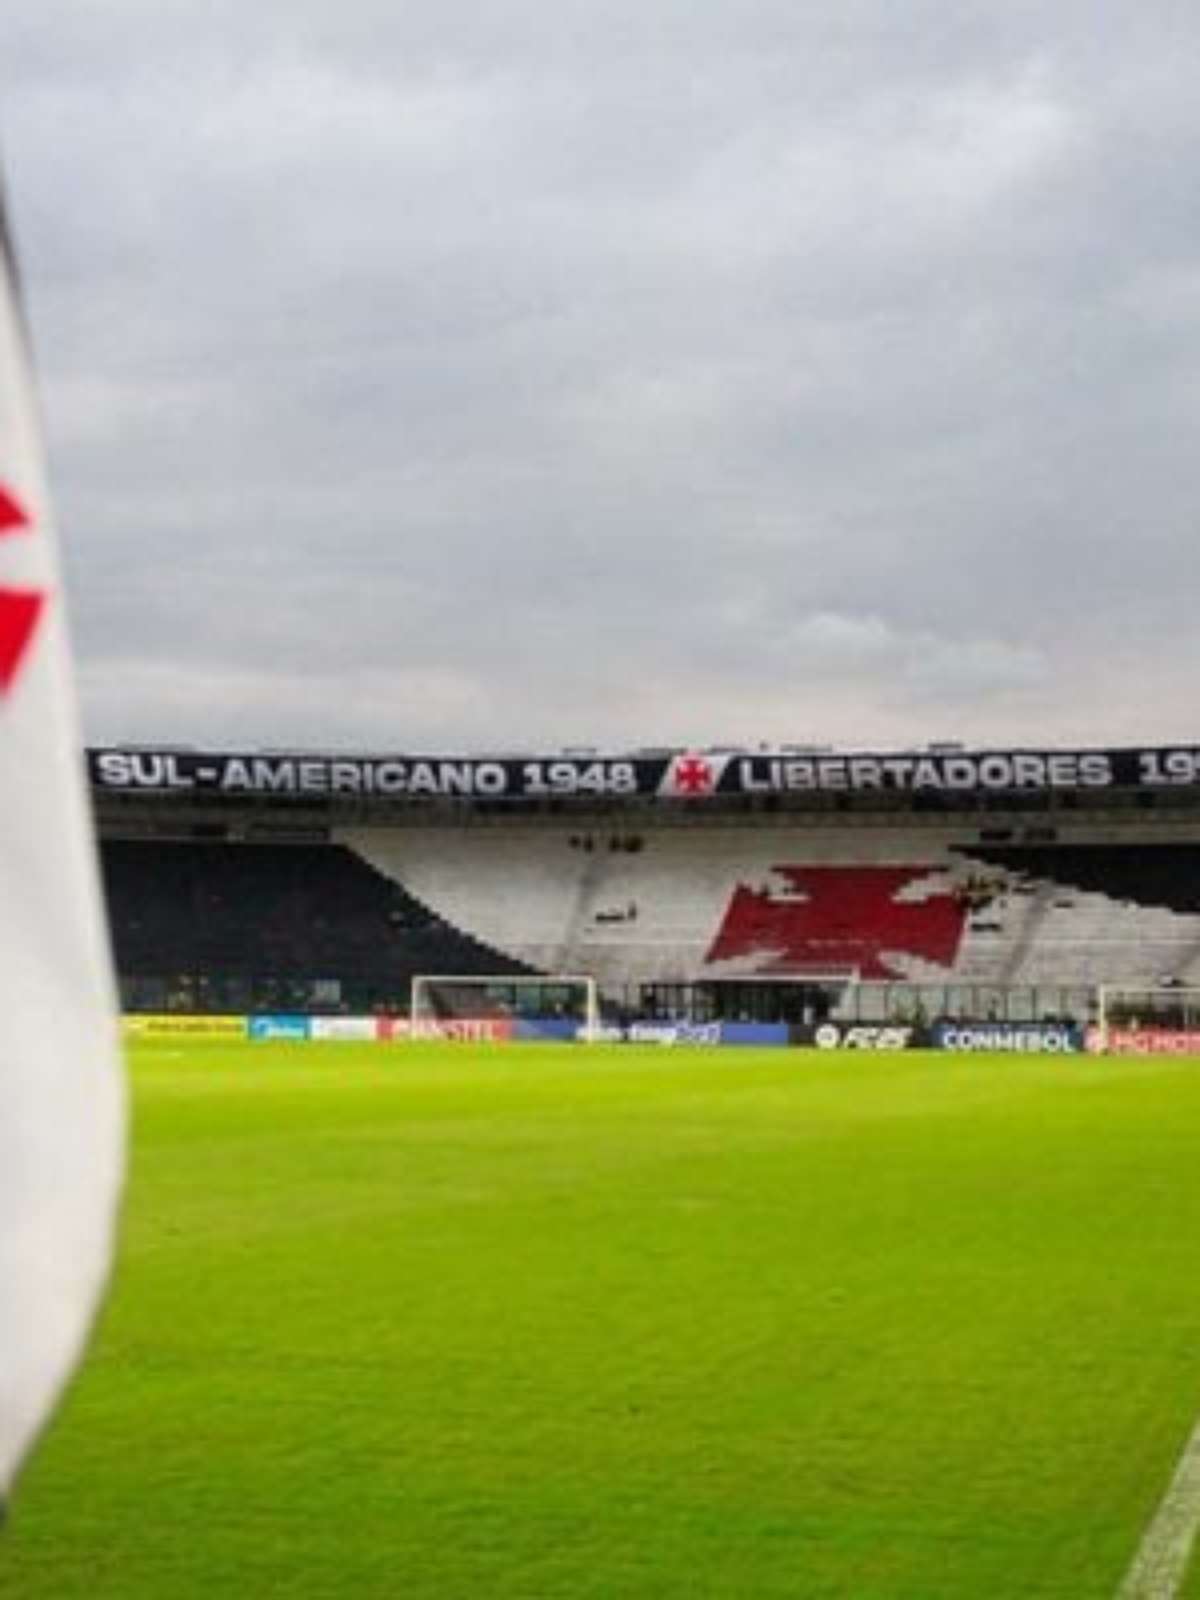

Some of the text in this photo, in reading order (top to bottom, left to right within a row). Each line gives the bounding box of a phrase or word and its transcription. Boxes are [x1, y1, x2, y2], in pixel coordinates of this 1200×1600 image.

[99, 754, 506, 793] SUL-AMERICANO
[523, 762, 636, 793] 1948
[740, 755, 1112, 789] LIBERTADORES
